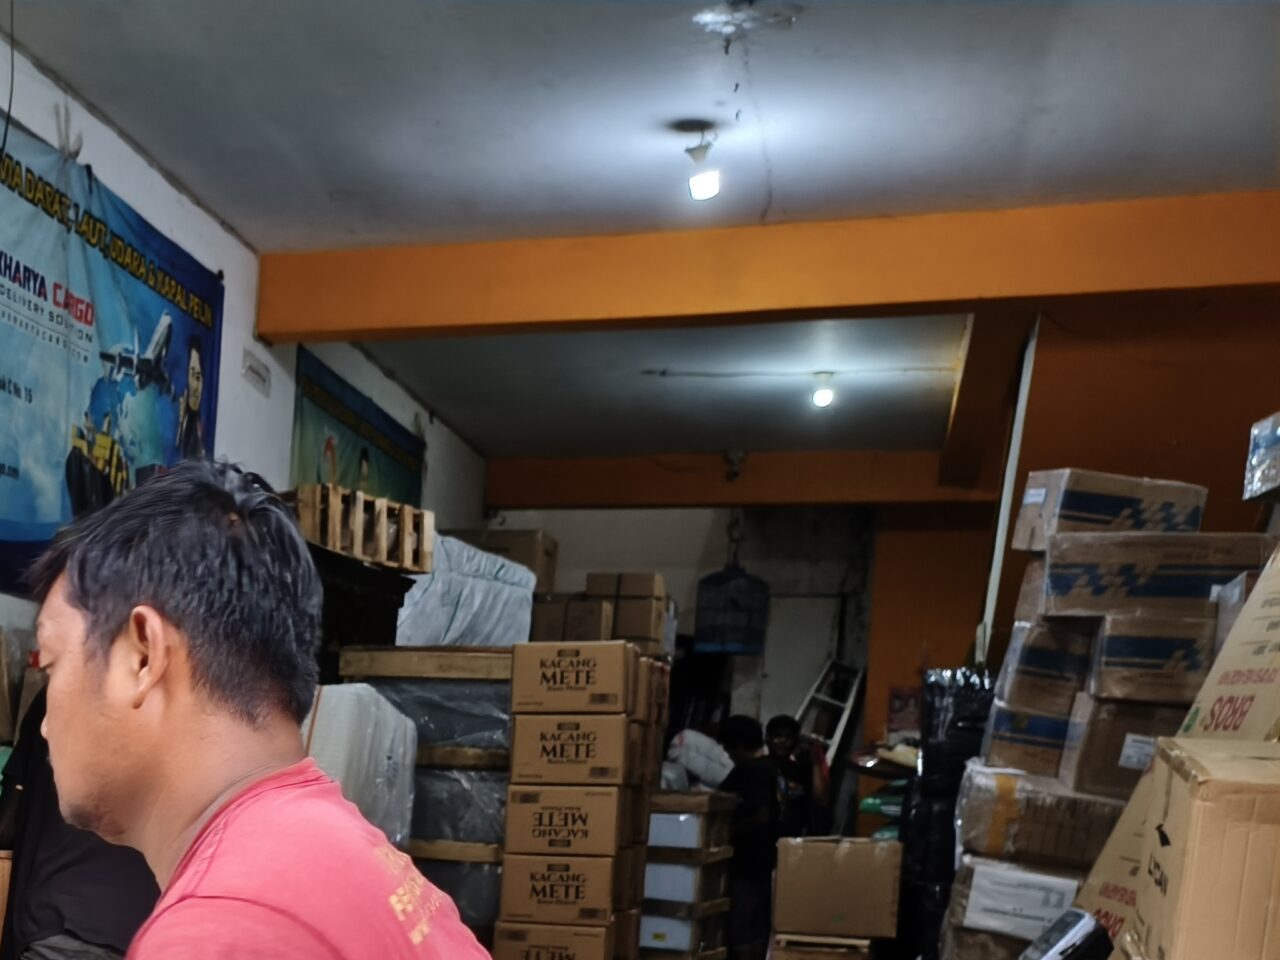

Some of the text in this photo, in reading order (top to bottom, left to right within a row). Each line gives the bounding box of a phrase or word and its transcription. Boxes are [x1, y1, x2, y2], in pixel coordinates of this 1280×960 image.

[0, 283, 45, 316] DELIVERY
[539, 658, 597, 669] KACANG
[539, 669, 597, 687] METE
[539, 731, 597, 742] KACANG
[539, 743, 597, 759] METE
[532, 811, 589, 827] METE
[532, 828, 589, 839] KACANG
[529, 872, 587, 884] KACANG
[529, 884, 587, 900] METE
